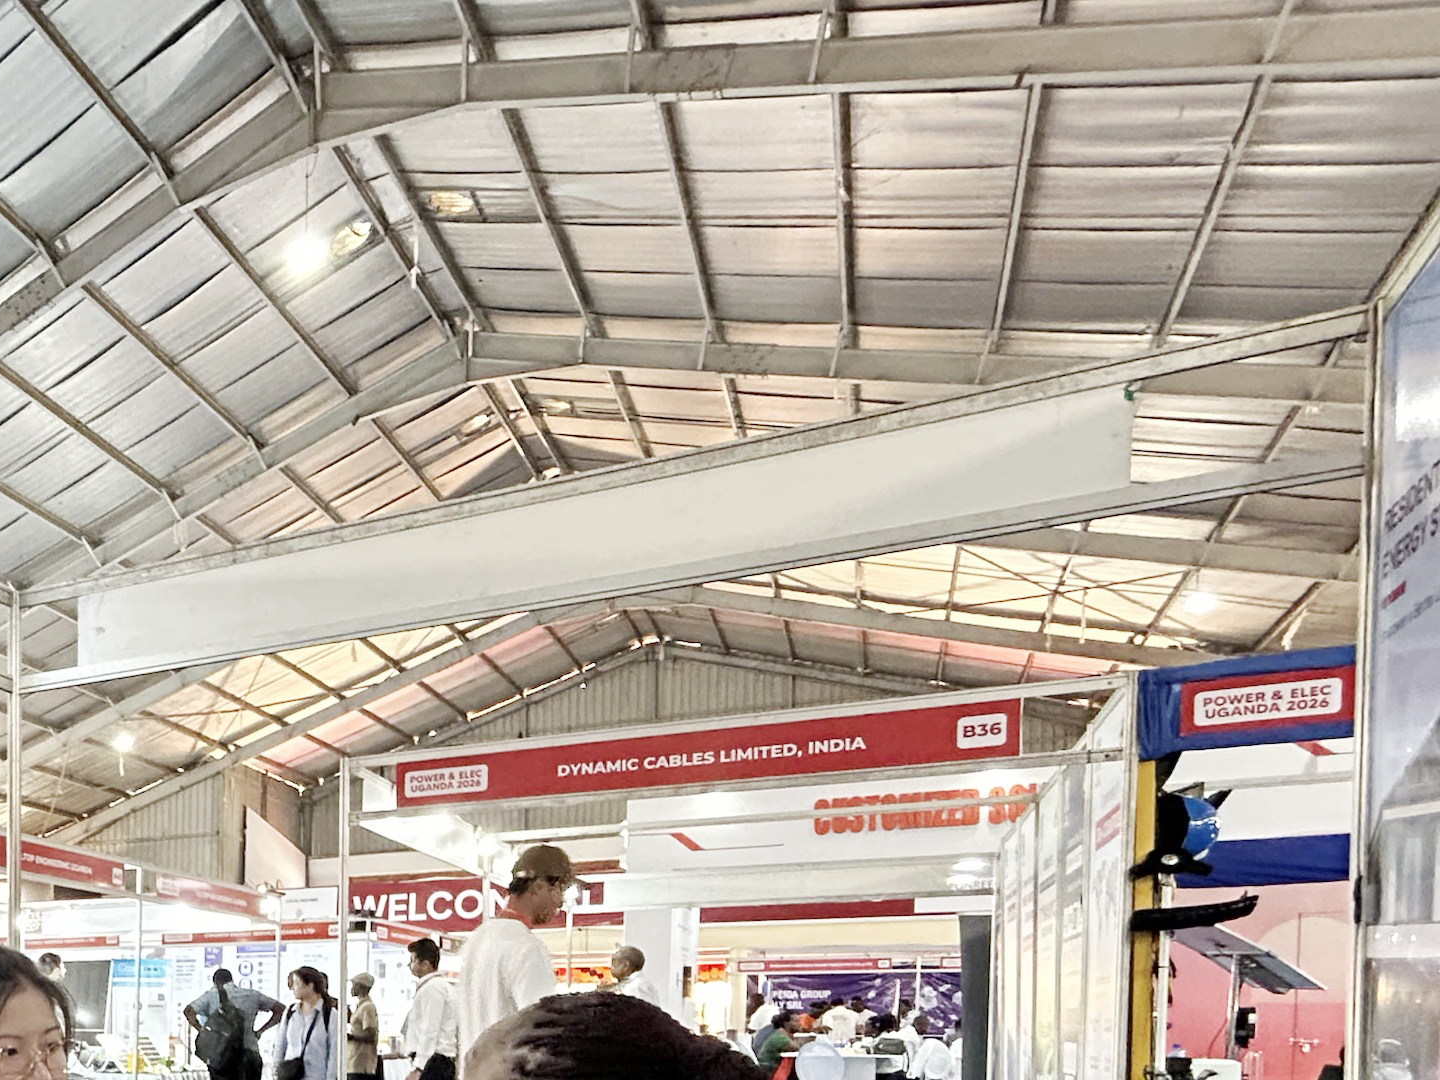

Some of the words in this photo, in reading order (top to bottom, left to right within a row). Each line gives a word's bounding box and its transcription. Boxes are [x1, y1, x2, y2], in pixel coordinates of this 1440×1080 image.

[1203, 692, 1266, 708] POWER
[1271, 690, 1282, 700] &
[1290, 685, 1331, 699] ELEC
[1205, 702, 1281, 719] UGANDA
[1287, 697, 1329, 711] 2026
[962, 721, 1002, 738] B36
[557, 757, 639, 777] DYNAMIC
[643, 750, 715, 769] CABLES
[719, 743, 803, 763] LIMITED,
[808, 736, 867, 755] INDIA
[409, 772, 445, 784] POWER
[448, 771, 456, 780] &
[458, 769, 482, 779] ELEC
[410, 781, 454, 793] UGANDA
[456, 779, 482, 789] 2026
[800, 989, 832, 999] GROUP
